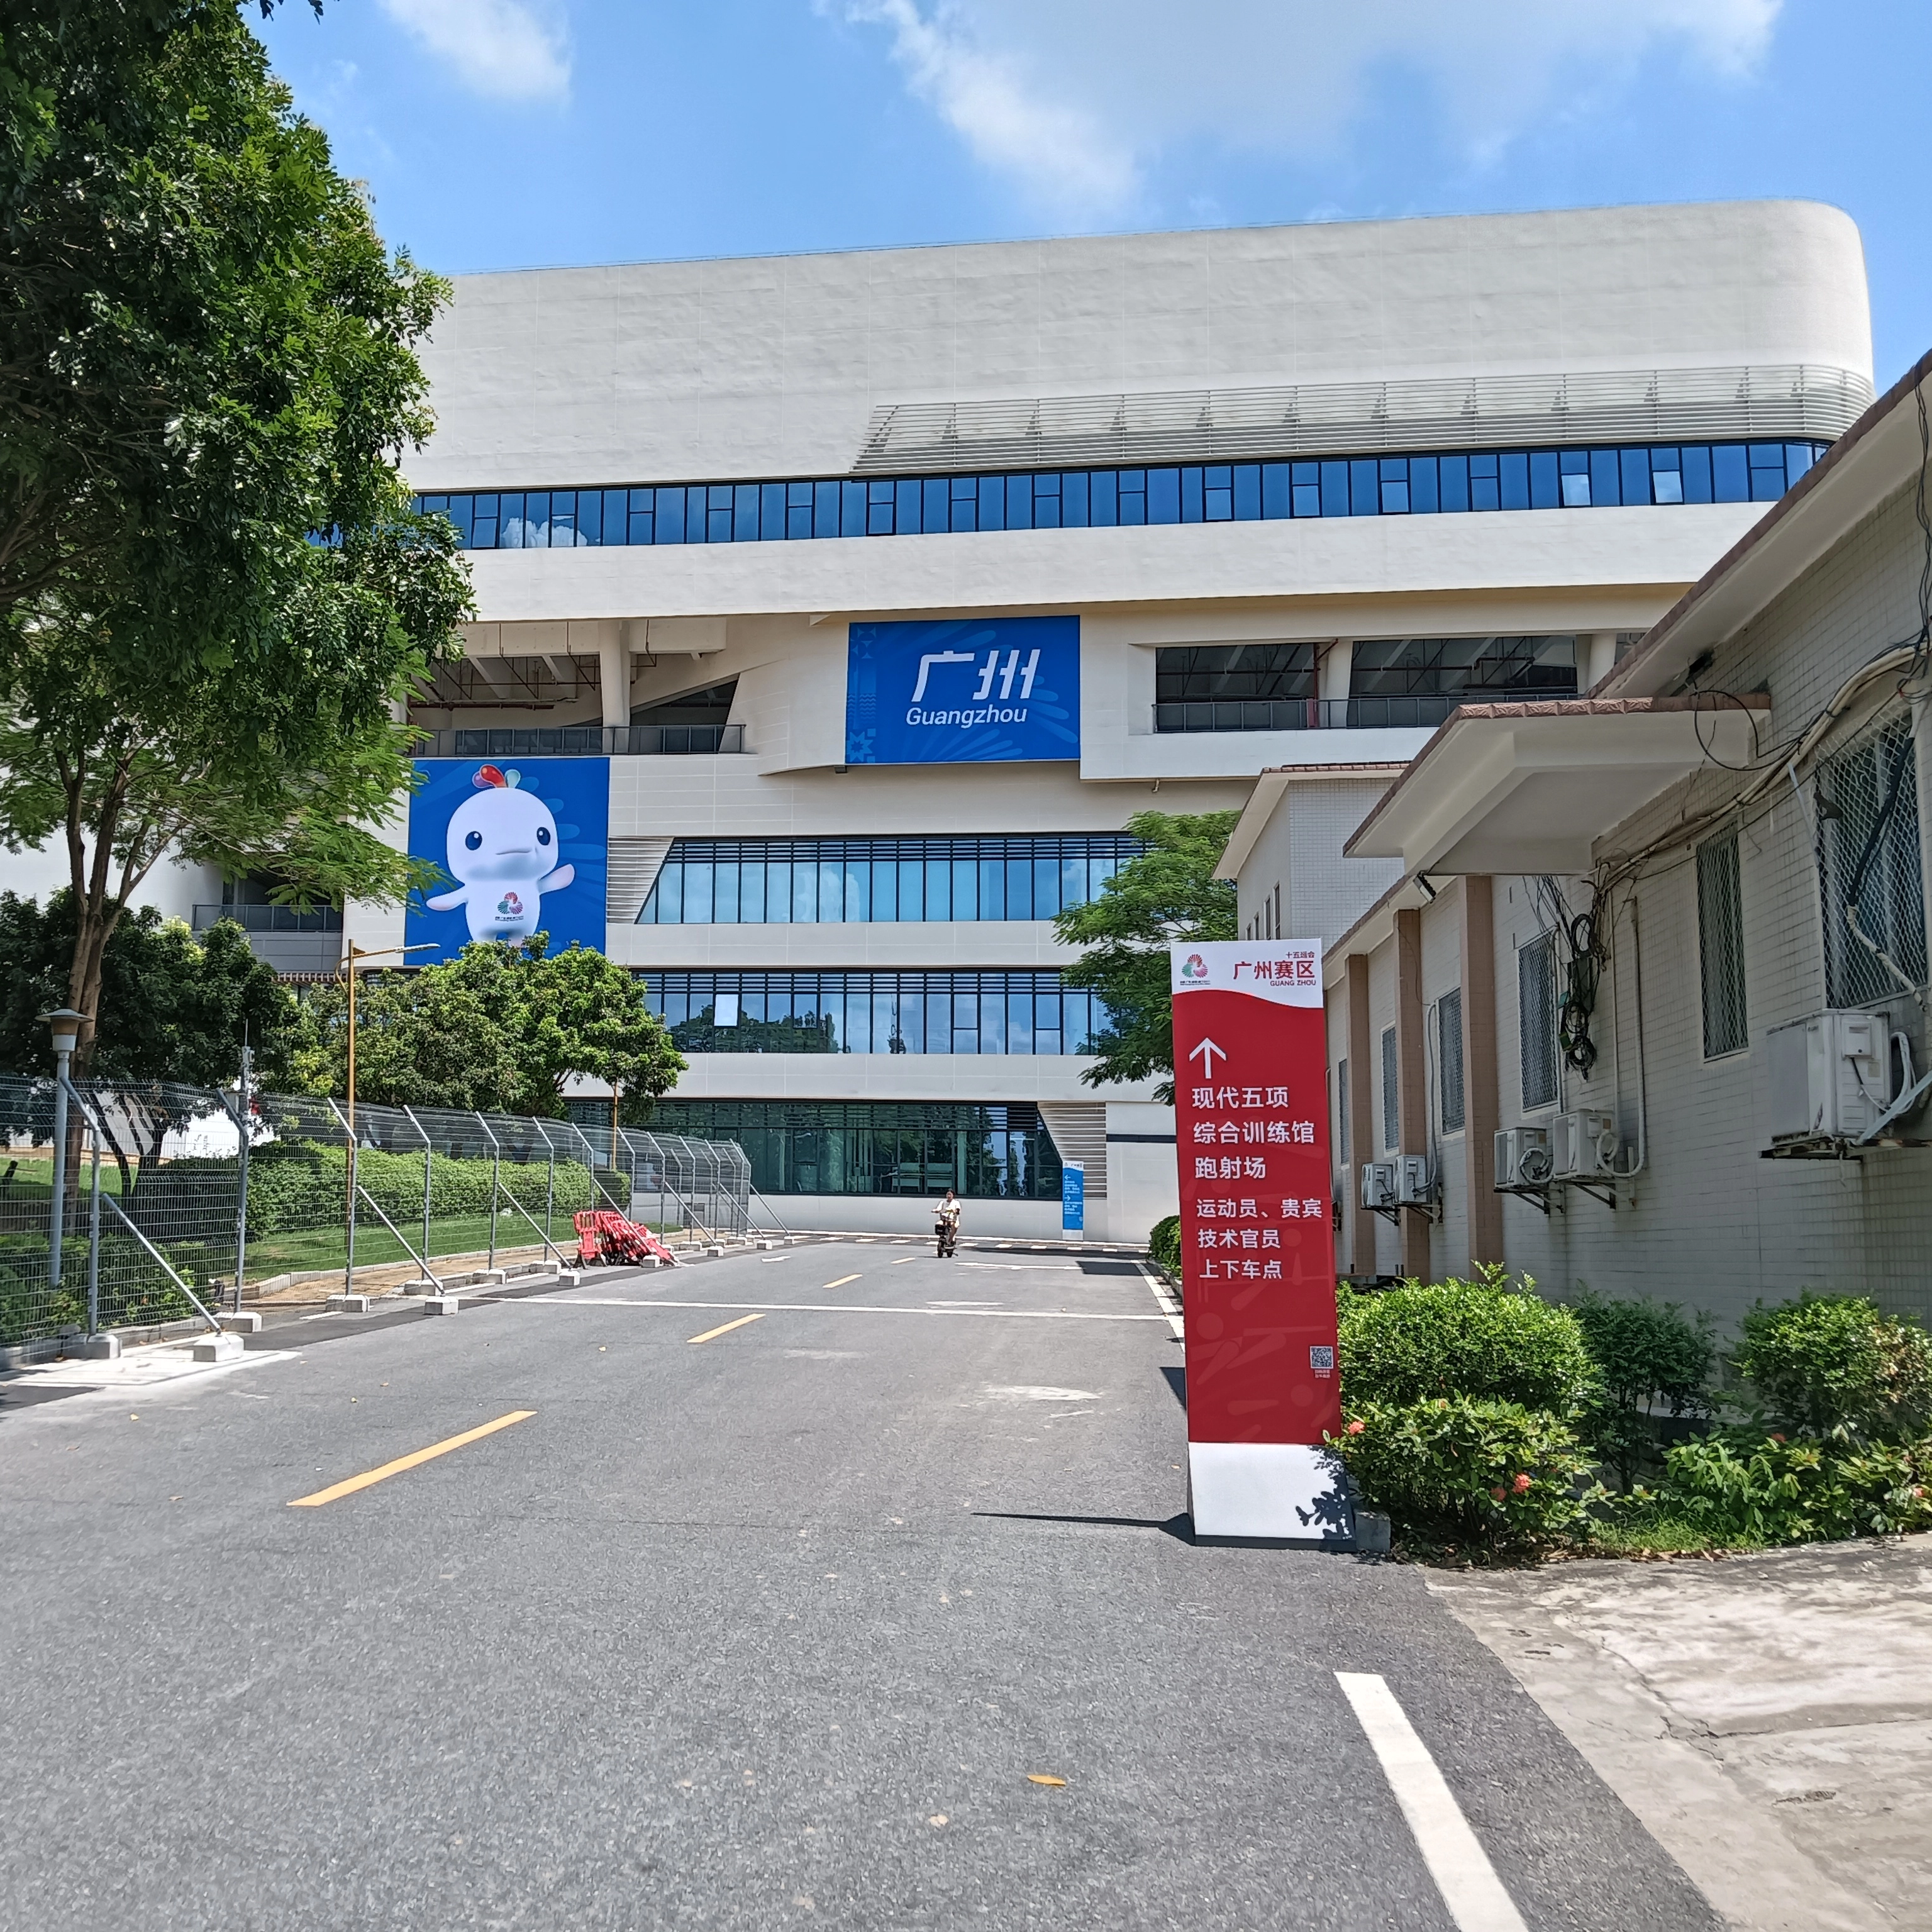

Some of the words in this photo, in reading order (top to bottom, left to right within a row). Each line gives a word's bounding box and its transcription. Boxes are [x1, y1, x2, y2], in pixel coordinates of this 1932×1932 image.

[911, 648, 1041, 702] 广州
[906, 704, 1027, 729] Guangzhou
[1233, 960, 1315, 980] 广州赛区
[1192, 1086, 1289, 1109] 现代五项
[1193, 1121, 1314, 1144] 综合训练馆
[1195, 1156, 1267, 1179] 跑射场
[1196, 1199, 1323, 1219] 运动员、贵宾
[1197, 1229, 1281, 1249] 技术官员
[1199, 1258, 1282, 1279] 上下车点
